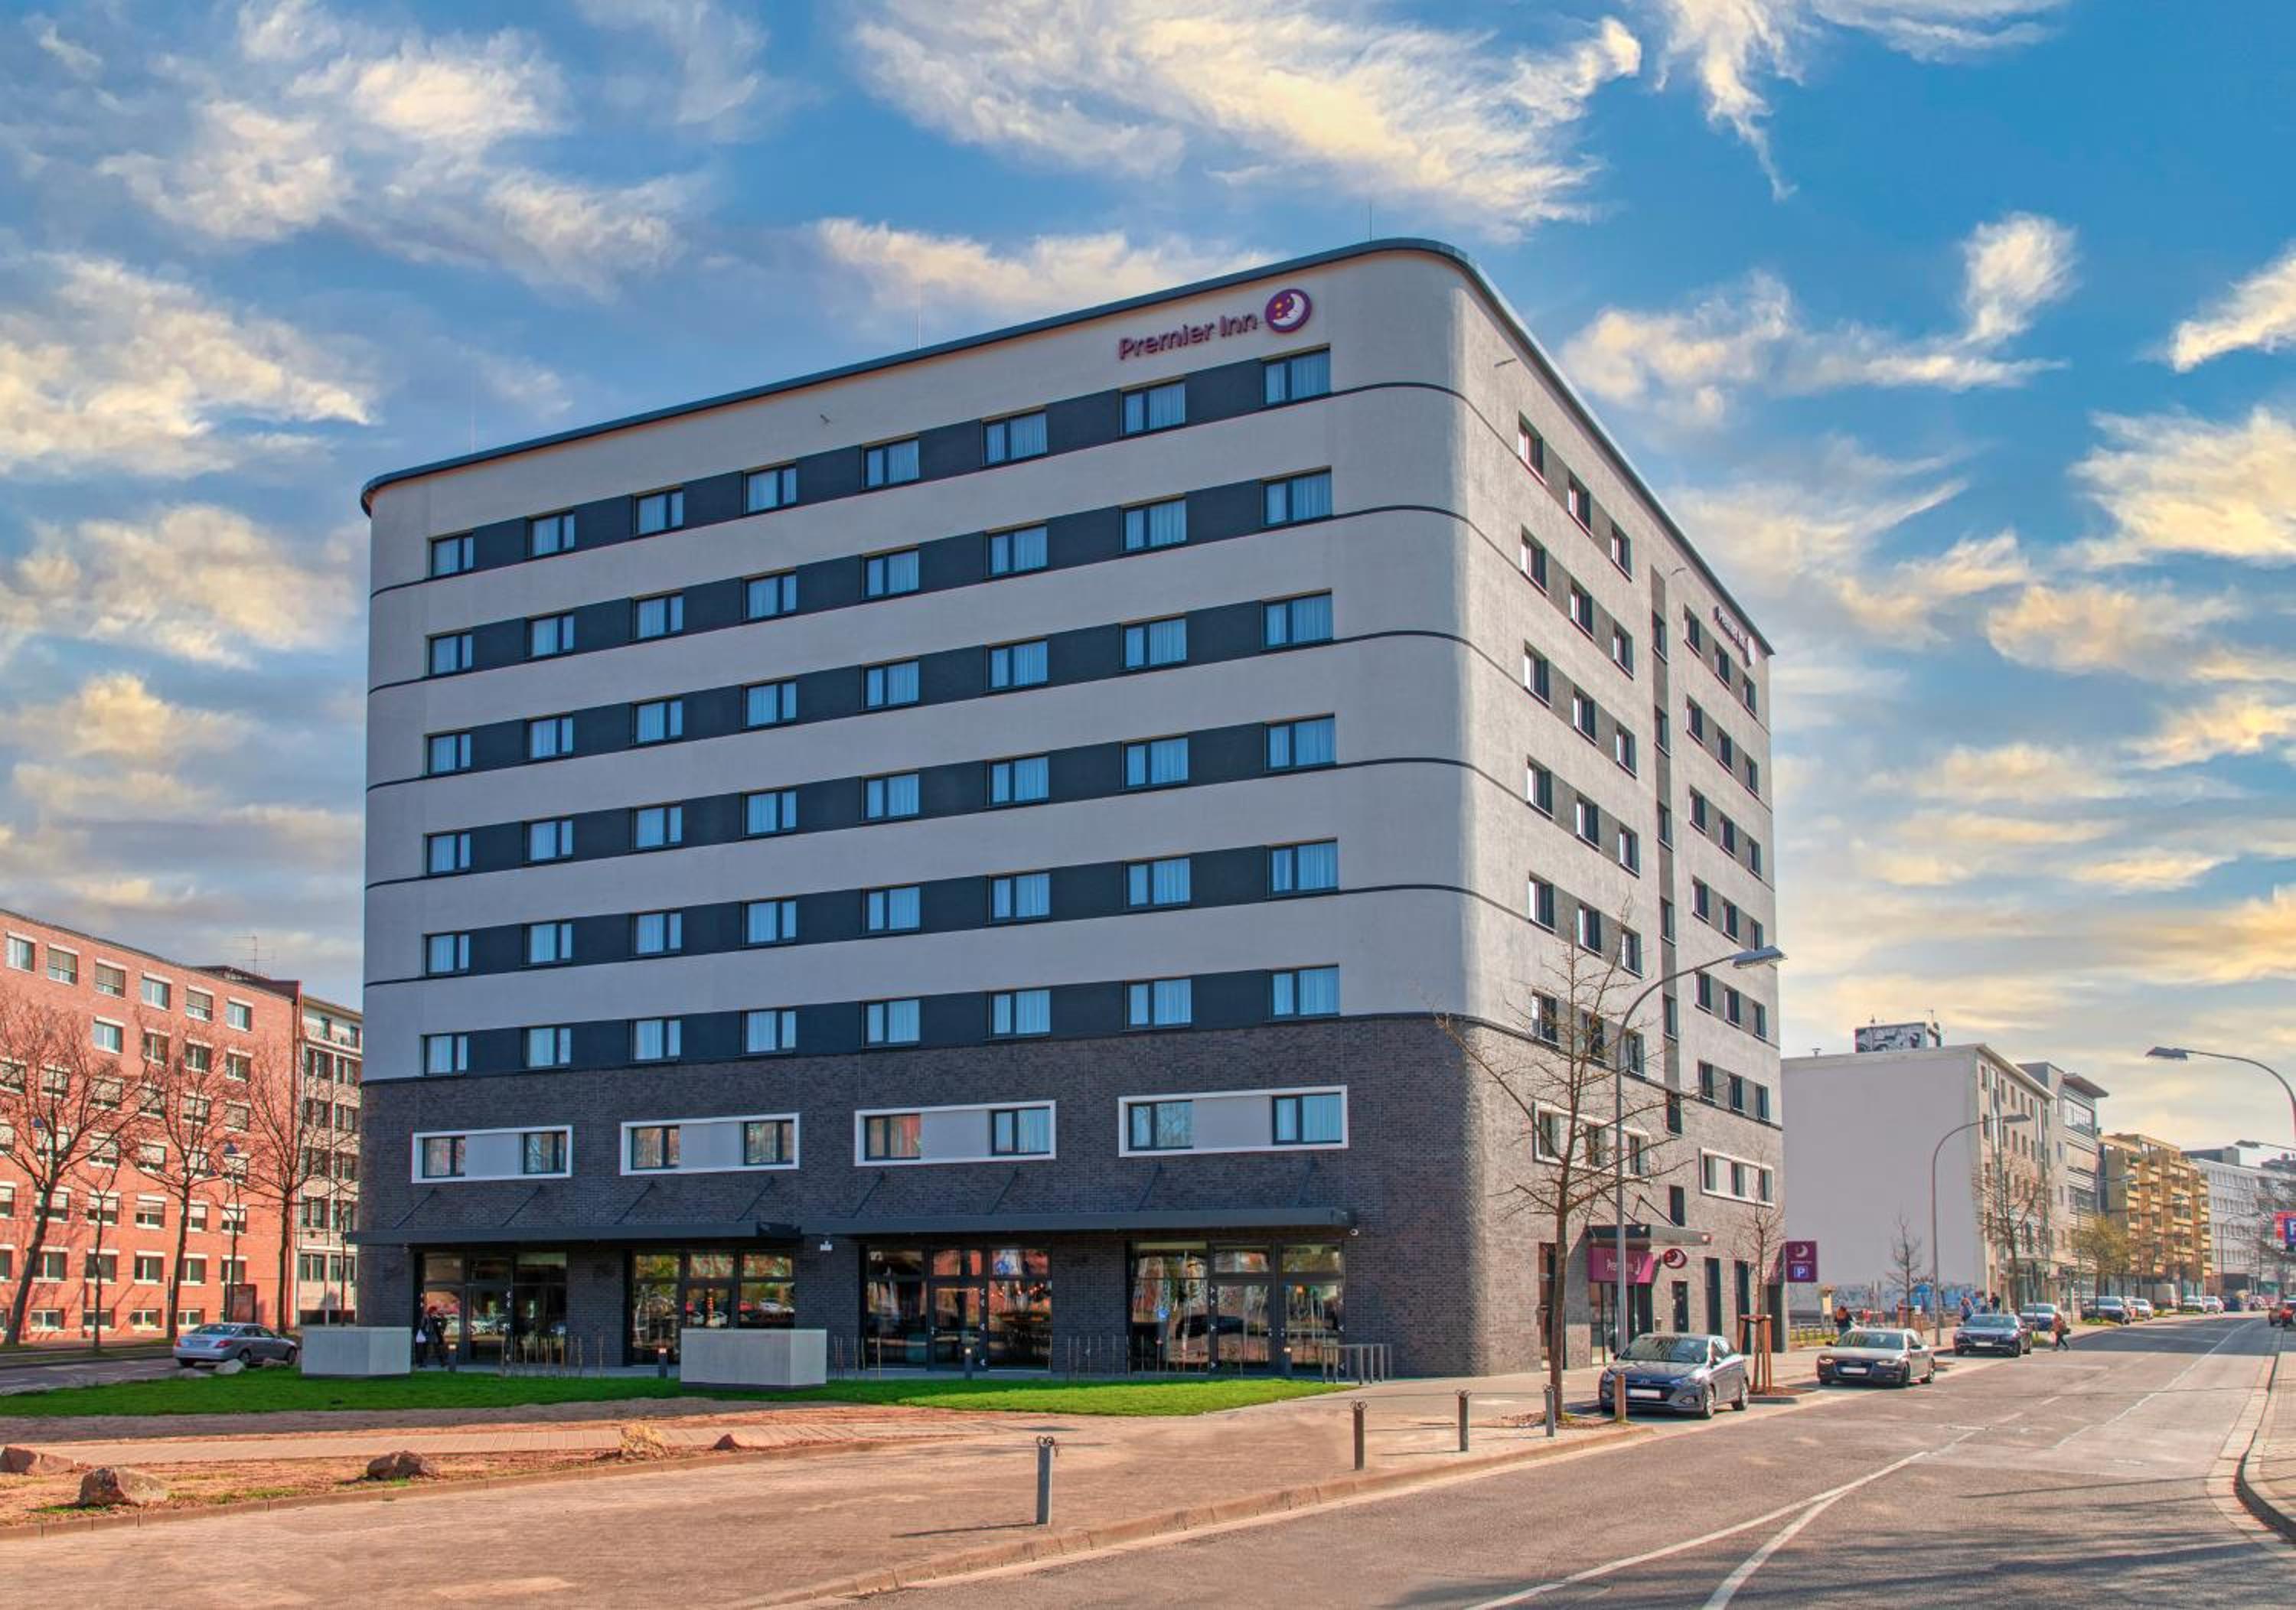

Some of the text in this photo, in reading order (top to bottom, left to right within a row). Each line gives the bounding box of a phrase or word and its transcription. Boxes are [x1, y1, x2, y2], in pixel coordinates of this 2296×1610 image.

[1119, 312, 1257, 360] Premier Inn
[1797, 1266, 1805, 1278] P
